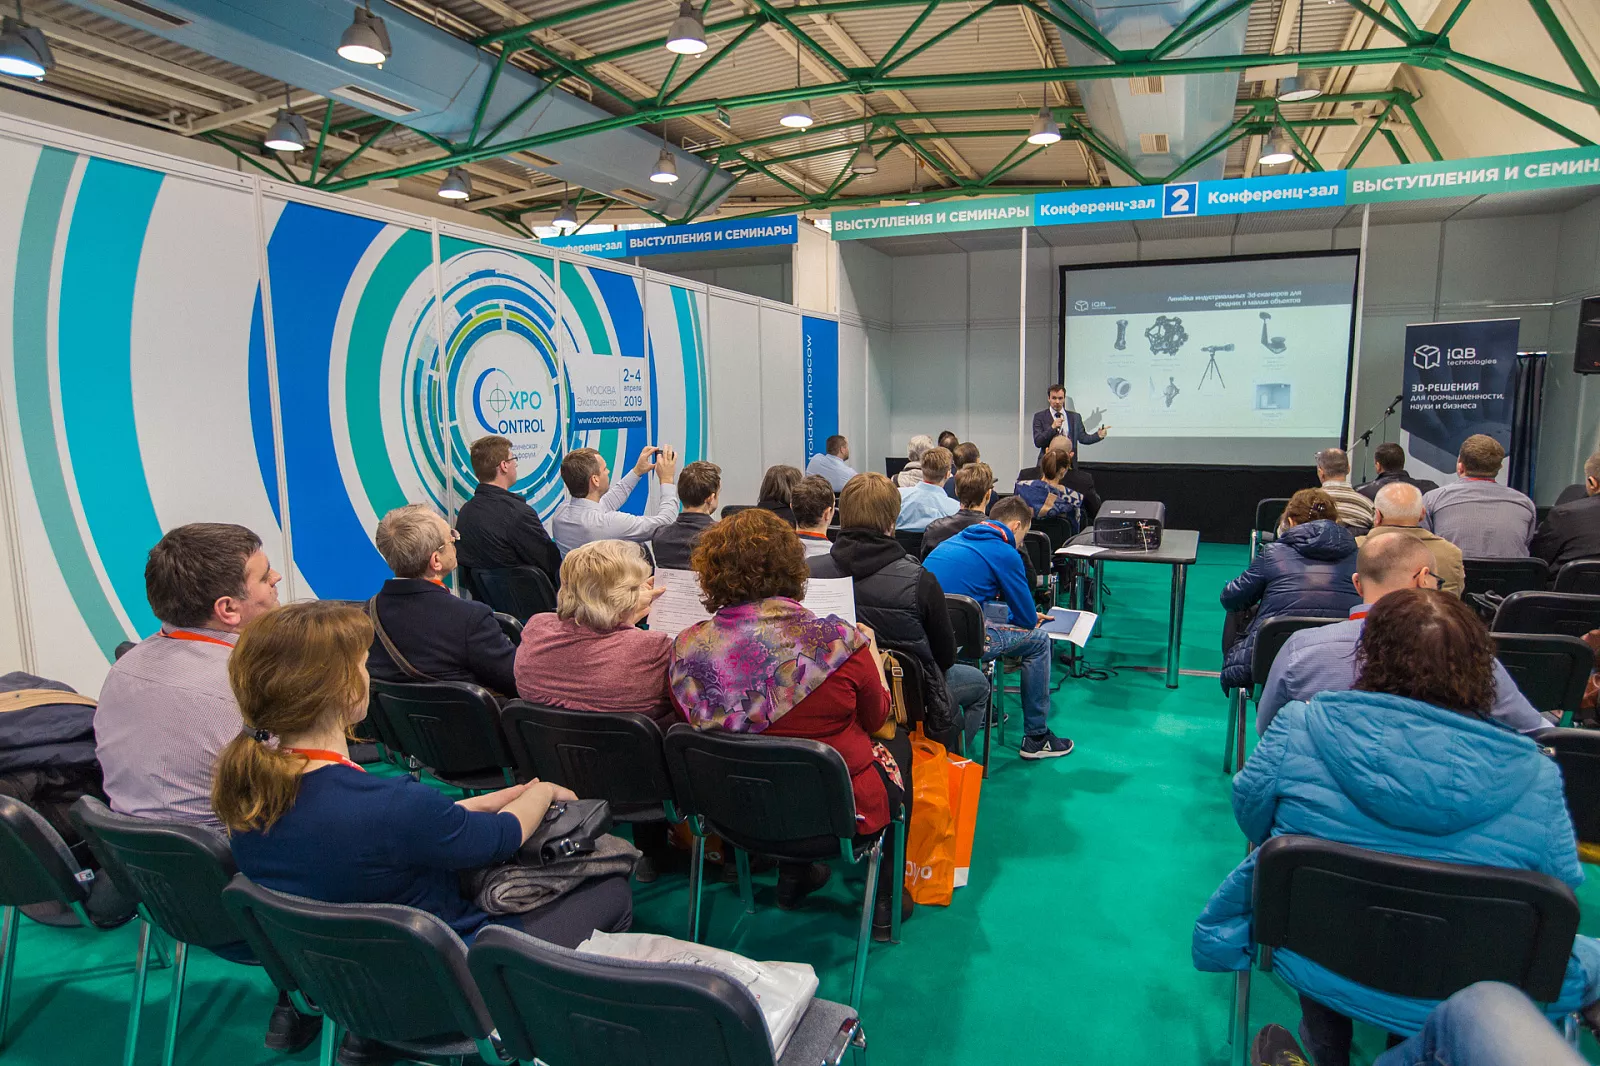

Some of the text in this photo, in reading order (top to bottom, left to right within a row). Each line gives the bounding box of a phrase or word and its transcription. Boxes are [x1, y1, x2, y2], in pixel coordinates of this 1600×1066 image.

[1352, 158, 1600, 194] ВЫСТУПЛЕНИЯ И СЕМИН
[1170, 188, 1190, 212] 2
[1208, 184, 1339, 205] Конференц-зал
[1040, 198, 1156, 217] Конференц-зал
[835, 206, 1030, 232] ВЫСТУПЛЕНИЯ И СЕМИНАРЫ
[629, 225, 793, 249] ВЫСТУПЛЕНИЯ И СЕМИНАРЫ
[1447, 348, 1477, 359] iQB
[623, 368, 641, 382] 2-4
[586, 385, 617, 395] МОСКВА
[1411, 382, 1479, 392] 3D-РЕШЕНИЯ
[624, 395, 643, 407] 2019
[806, 334, 814, 461] troldays.moscow
[1427, 393, 1505, 401] промышленности,
[1410, 403, 1434, 411] науки
